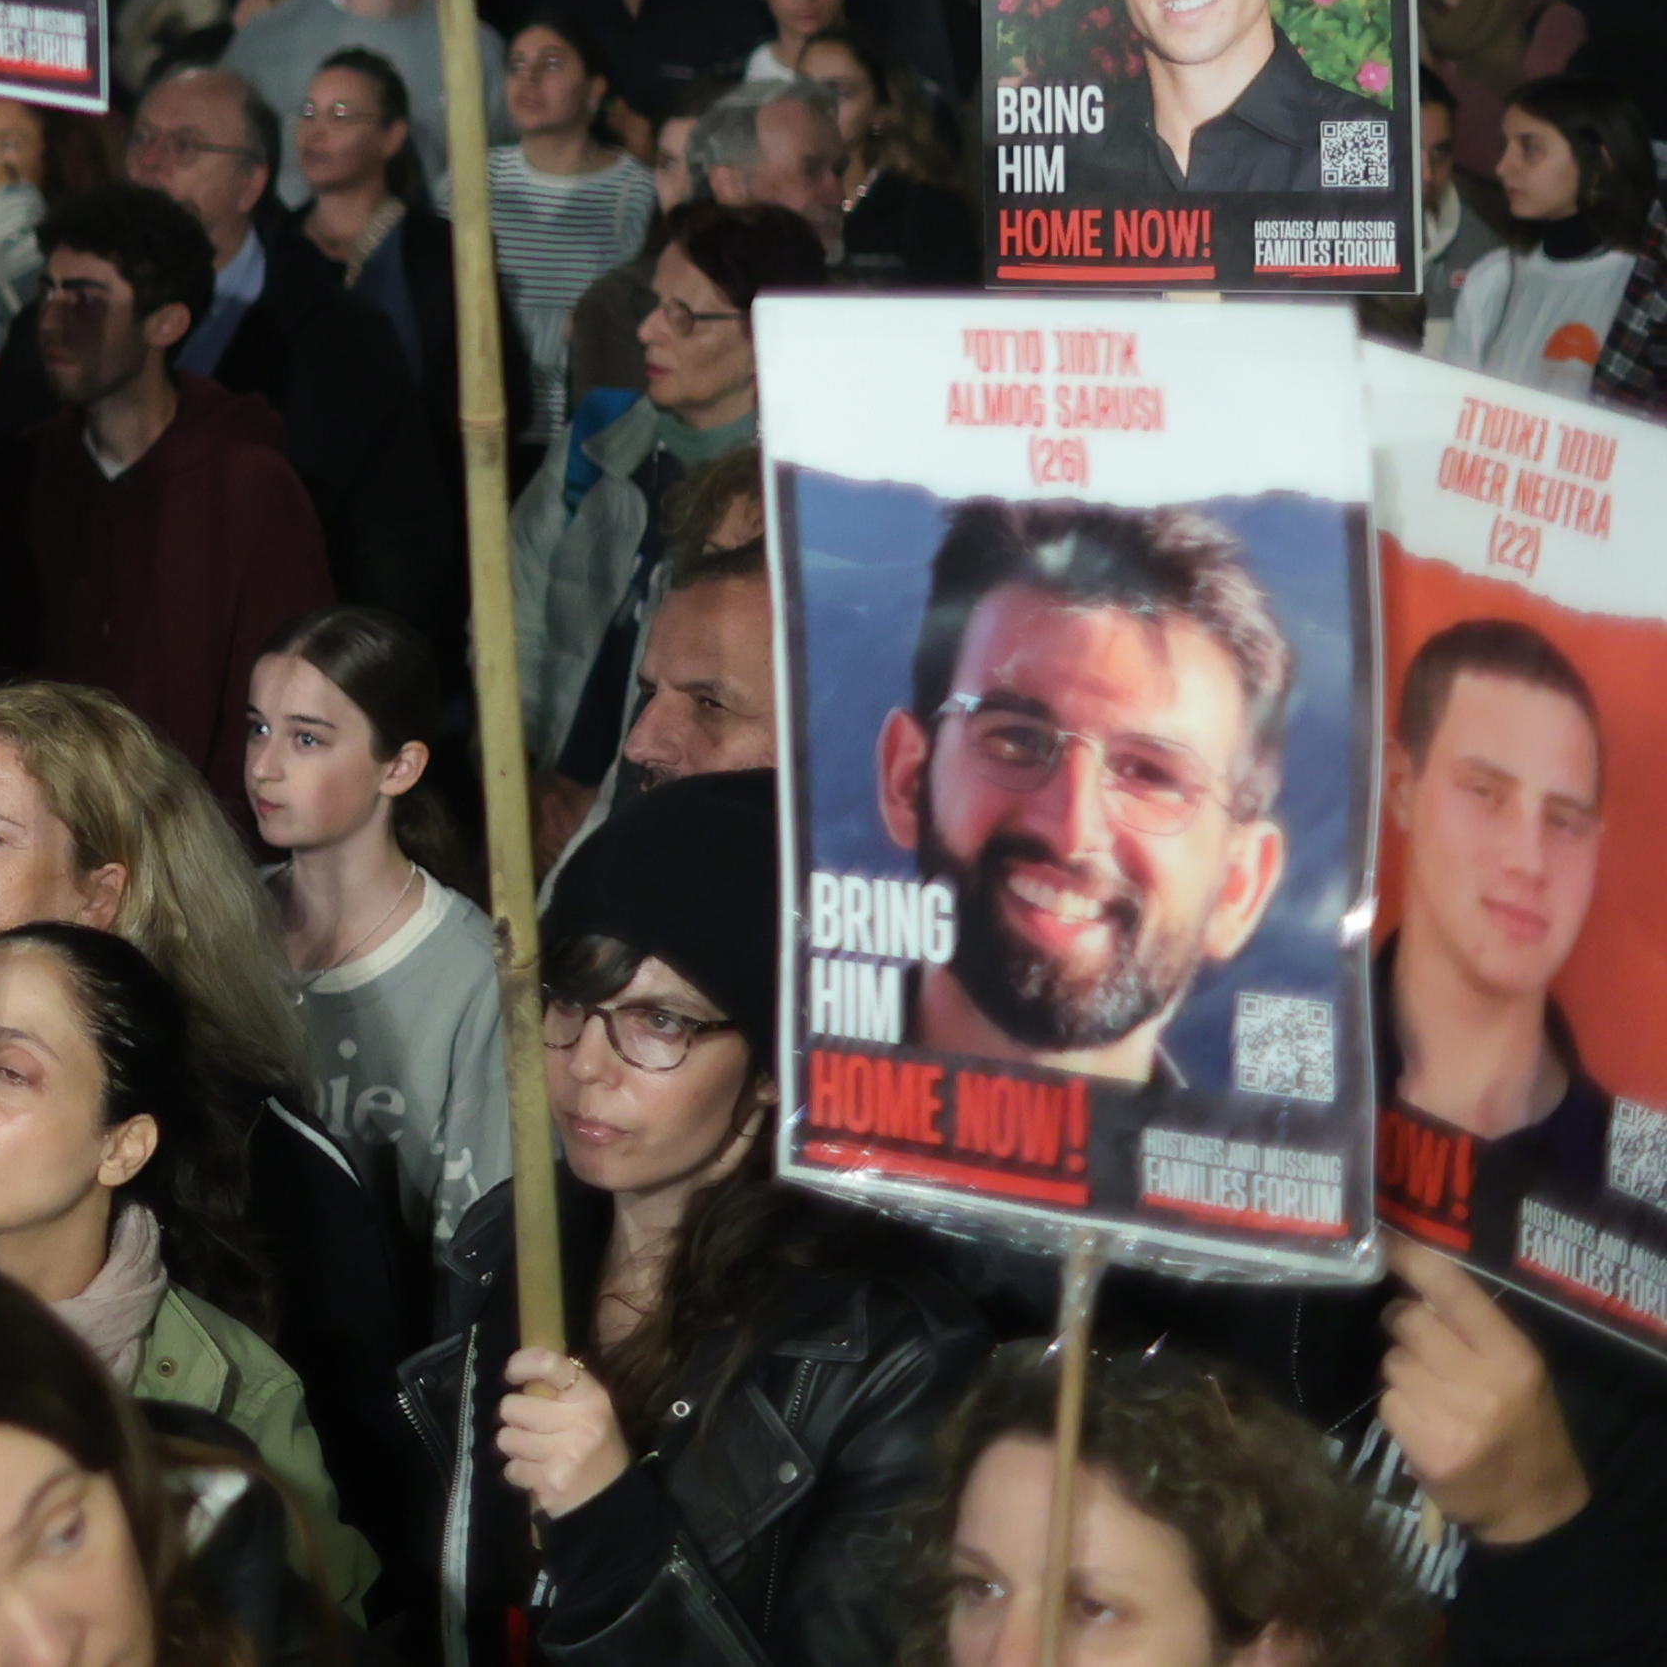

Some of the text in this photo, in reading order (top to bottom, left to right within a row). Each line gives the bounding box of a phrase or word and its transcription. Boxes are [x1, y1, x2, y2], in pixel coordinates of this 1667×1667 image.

[996, 85, 1105, 133] BRING
[997, 145, 1065, 193] HIM
[998, 209, 1212, 257] HOME NOW!
[1254, 220, 1396, 240] HOSTAGES AND MISSING
[1254, 239, 1397, 268] FAMILIES FORUM
[948, 382, 1167, 431] ALMOG SARUSI
[1029, 434, 1090, 487] (26)
[1438, 446, 1612, 541] OMER NEUTRA
[1487, 513, 1541, 578] (22)
[808, 871, 956, 964] BRING
[808, 956, 902, 1046] HIM
[315, 1038, 406, 1146] ie
[807, 1051, 1088, 1172] HOME NOW!
[1141, 1129, 1342, 1182] HOSTAGES AND MISSING
[1144, 1155, 1342, 1224] FAMILIES FORUM
[1522, 1197, 1596, 1251] HOSTAGES
[1521, 1223, 1614, 1297] FAMILIES
